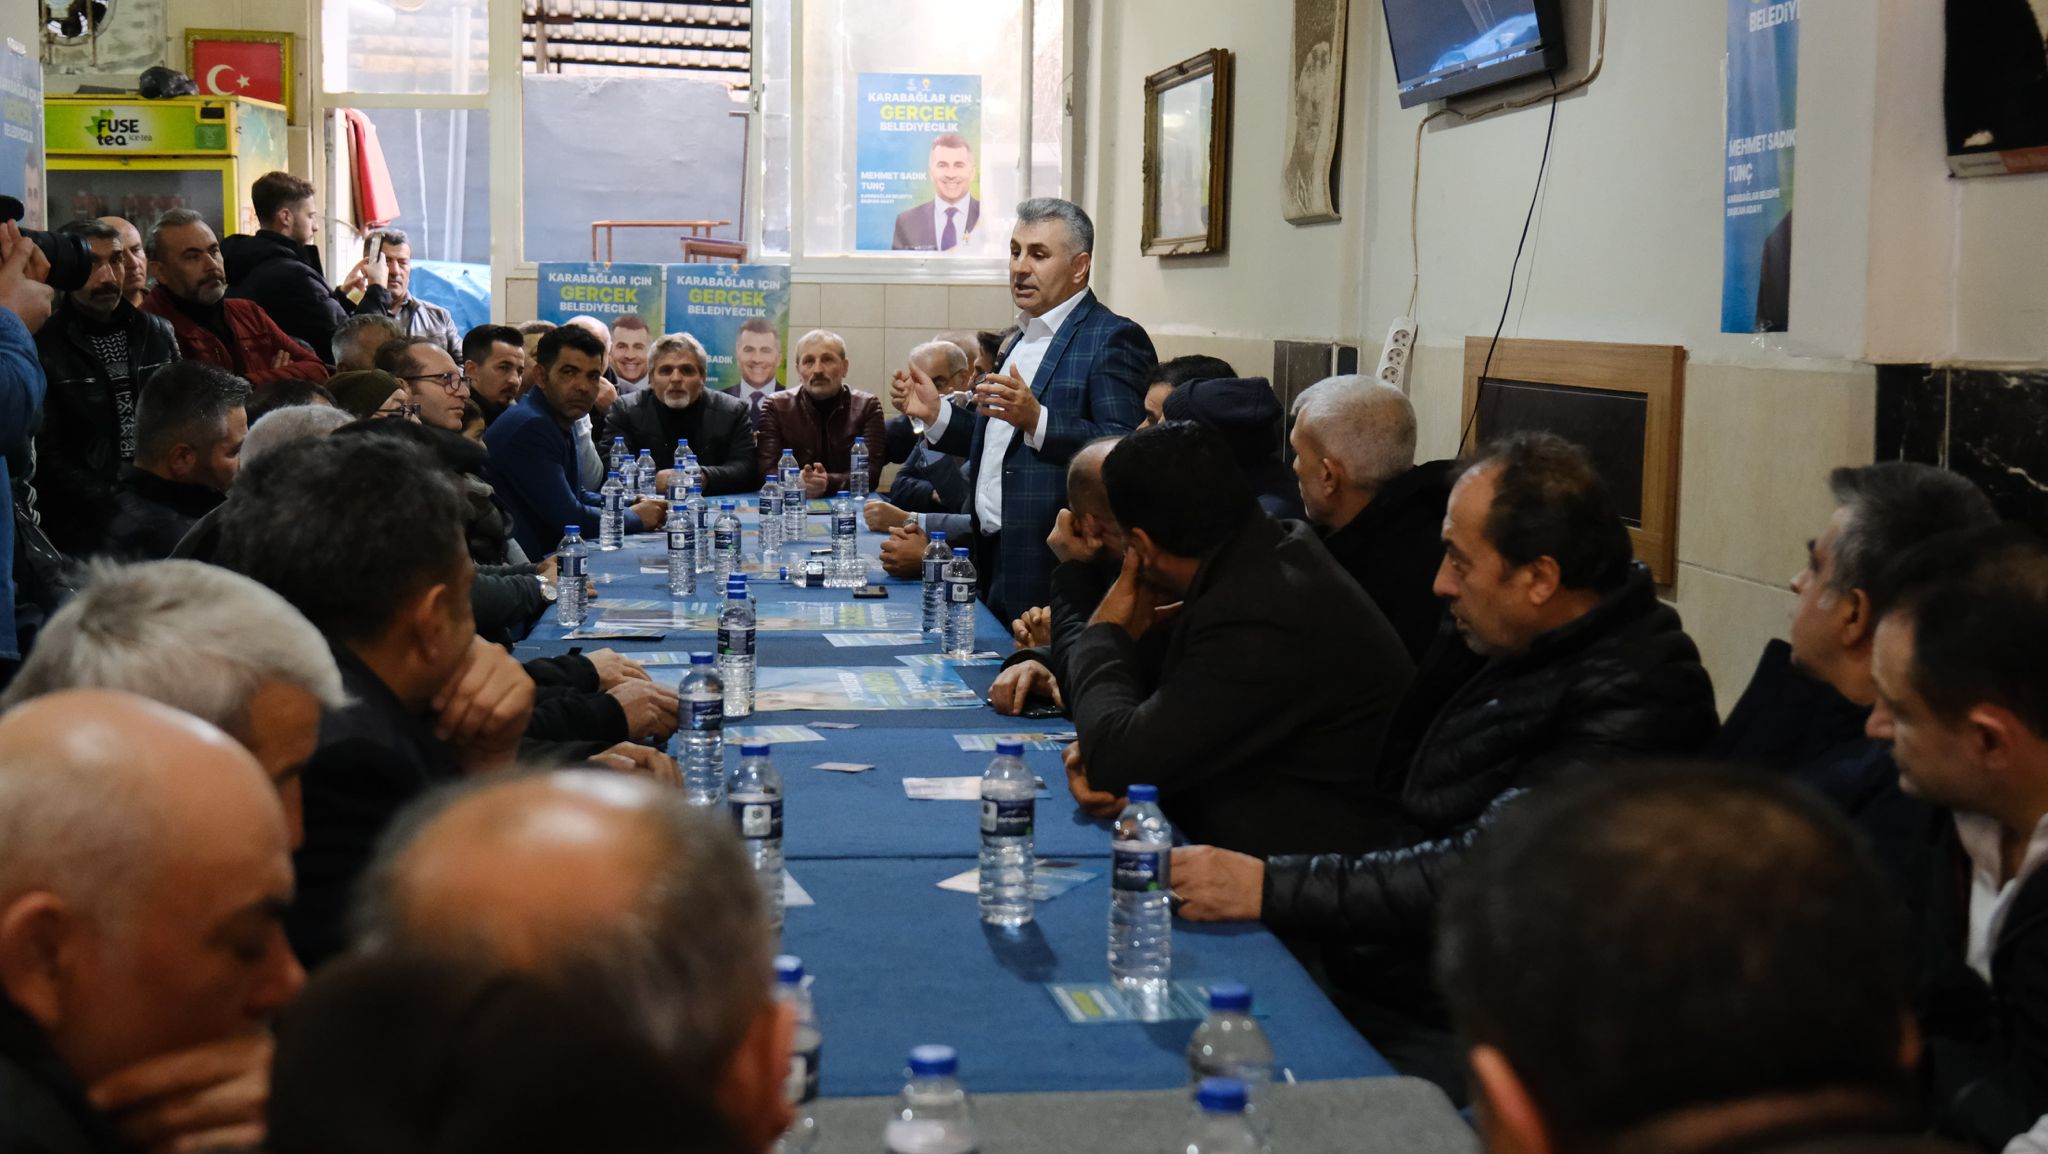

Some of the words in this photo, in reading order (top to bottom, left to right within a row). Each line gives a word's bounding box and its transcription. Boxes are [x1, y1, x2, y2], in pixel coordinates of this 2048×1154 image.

[867, 91, 946, 104] KARABAĞLAR
[880, 104, 959, 122] GERÇEK
[97, 119, 139, 133] FUSE
[96, 133, 127, 146] tea
[1728, 134, 1767, 157] MEHMET
[861, 171, 899, 180] MEHMET
[548, 272, 626, 285] KARABAĞLAR
[676, 275, 754, 289] KARABAĞLAR
[560, 285, 638, 303] GERÇEK
[688, 287, 767, 307] GERÇEK
